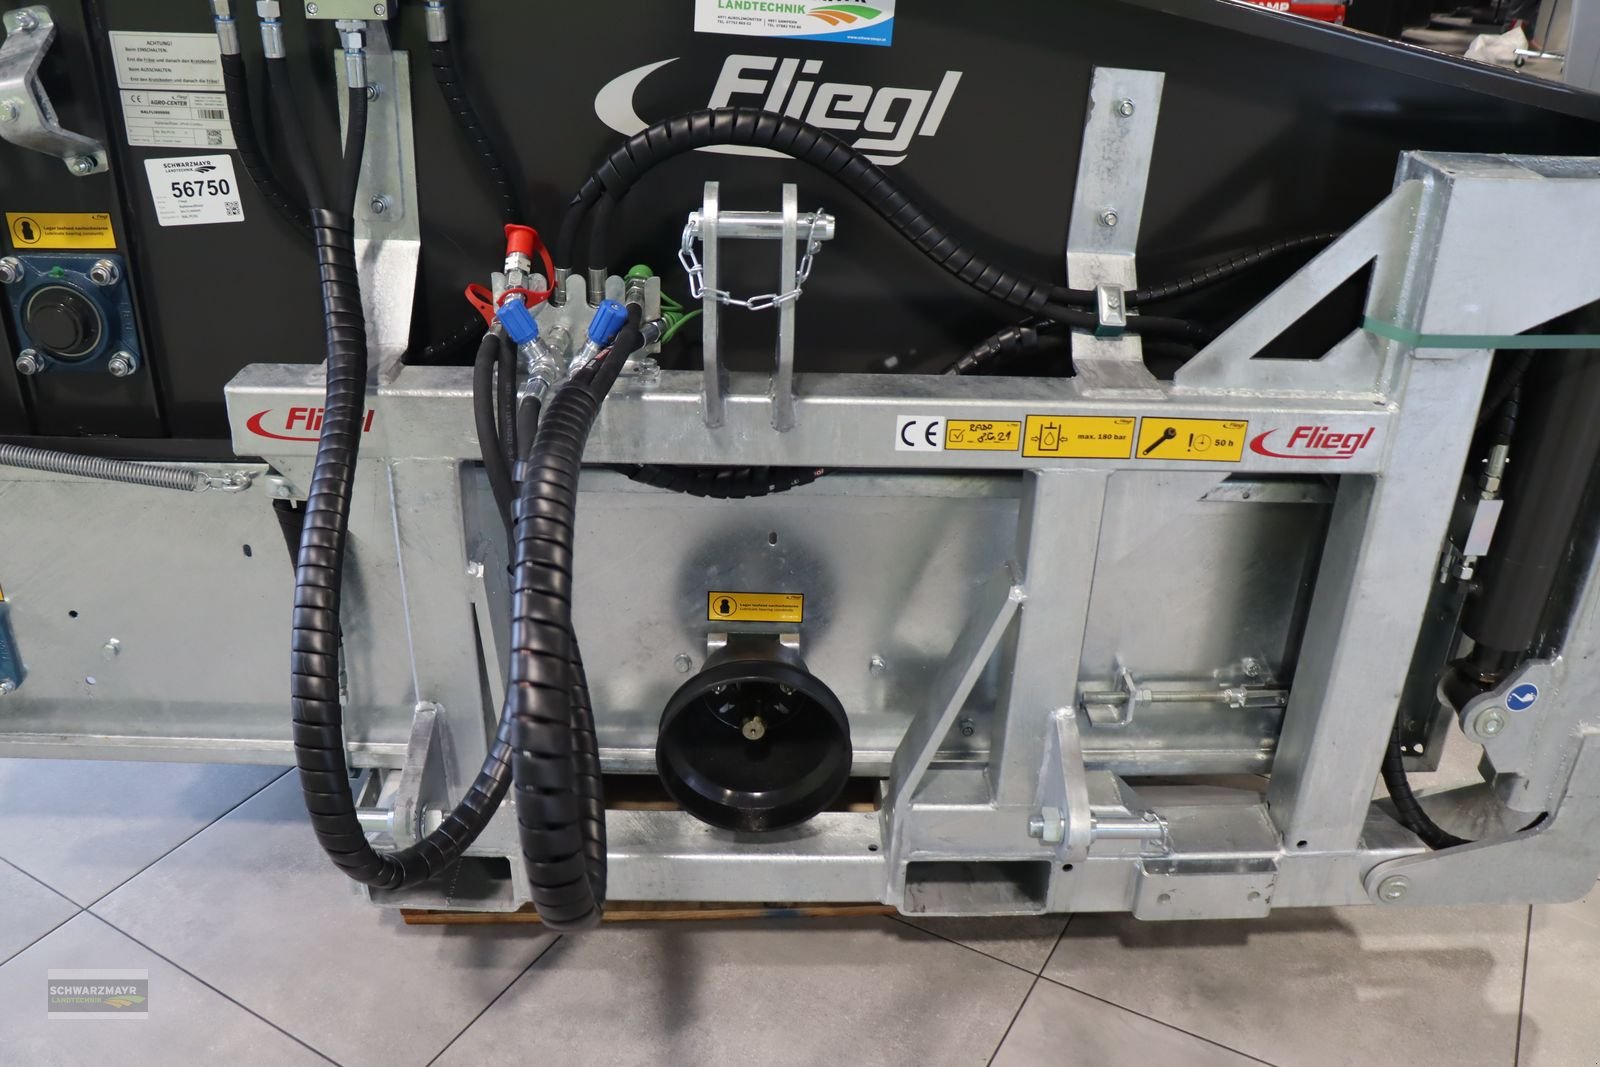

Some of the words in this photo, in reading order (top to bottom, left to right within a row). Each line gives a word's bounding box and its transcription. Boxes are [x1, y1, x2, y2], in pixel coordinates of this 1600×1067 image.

[718, 0, 806, 14] LANDTECHNIK
[707, 54, 963, 152] Fliegl
[163, 160, 211, 169] SCHWARZMAYR
[171, 178, 230, 198] 56750
[285, 407, 375, 433] Flil
[1287, 426, 1375, 454] Fliegl
